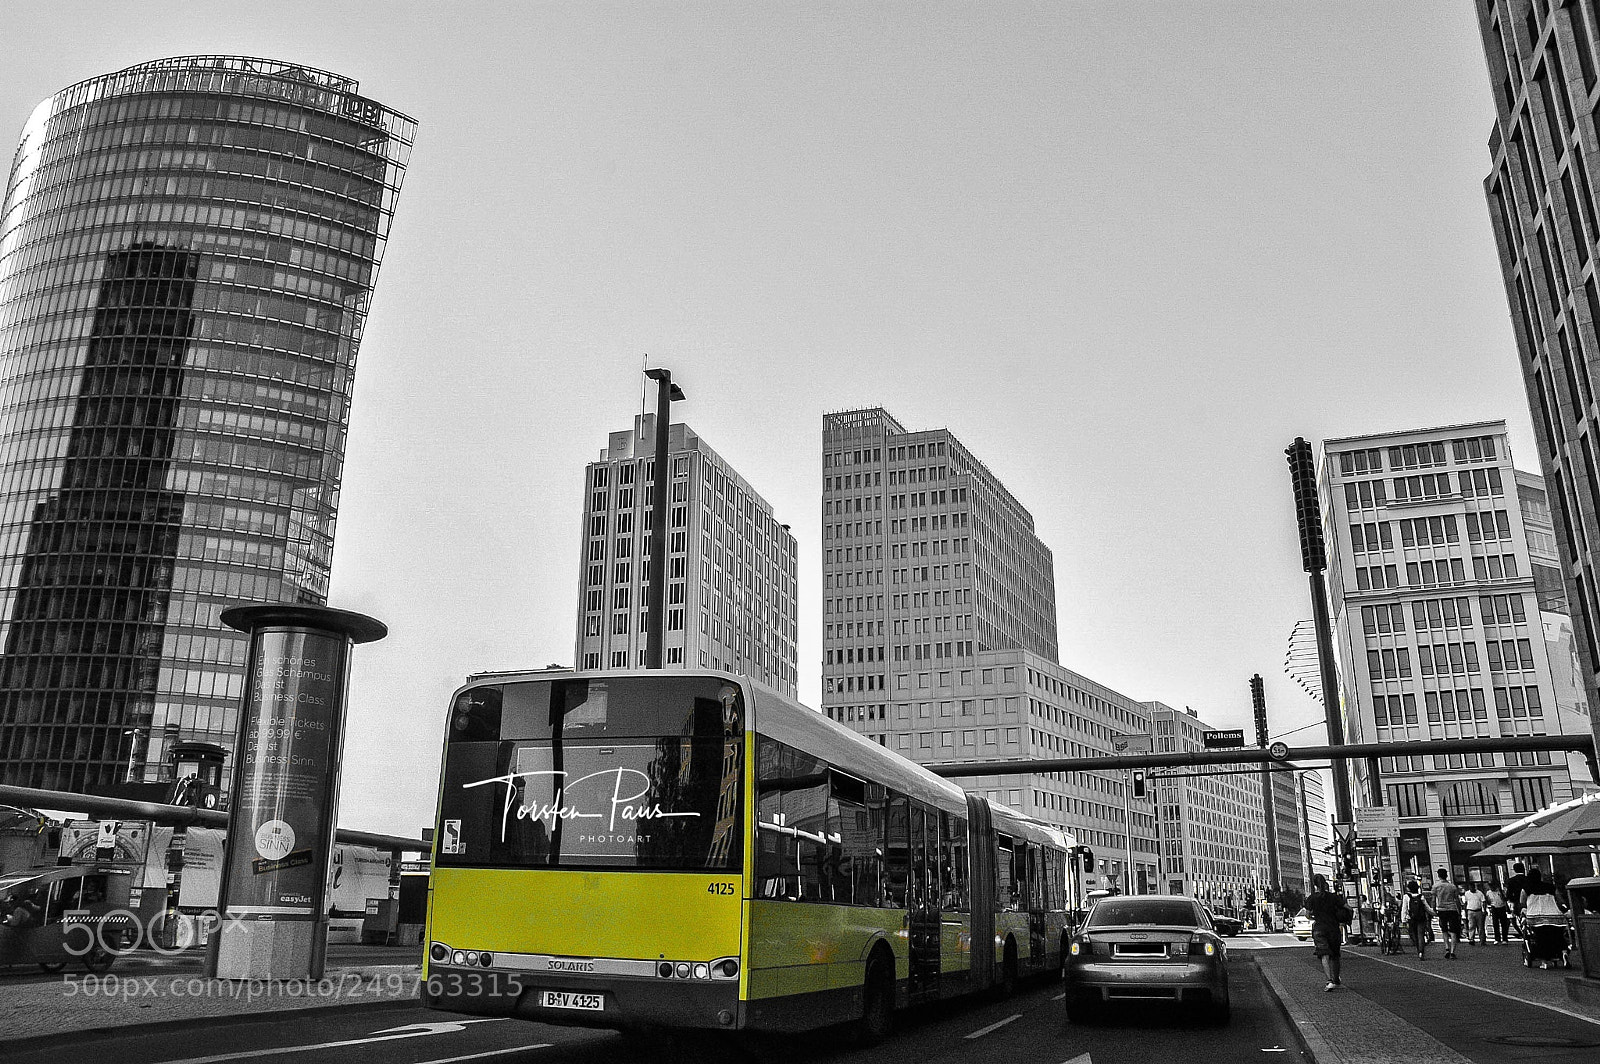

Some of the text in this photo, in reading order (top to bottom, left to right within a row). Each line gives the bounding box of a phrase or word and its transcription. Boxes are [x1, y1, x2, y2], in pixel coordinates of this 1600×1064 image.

[272, 655, 316, 667] schönes
[277, 667, 332, 682] Schampus
[260, 839, 290, 853] SINN
[707, 882, 735, 896] 4125
[280, 895, 312, 904] easyJet
[547, 960, 594, 972] SOLARIS
